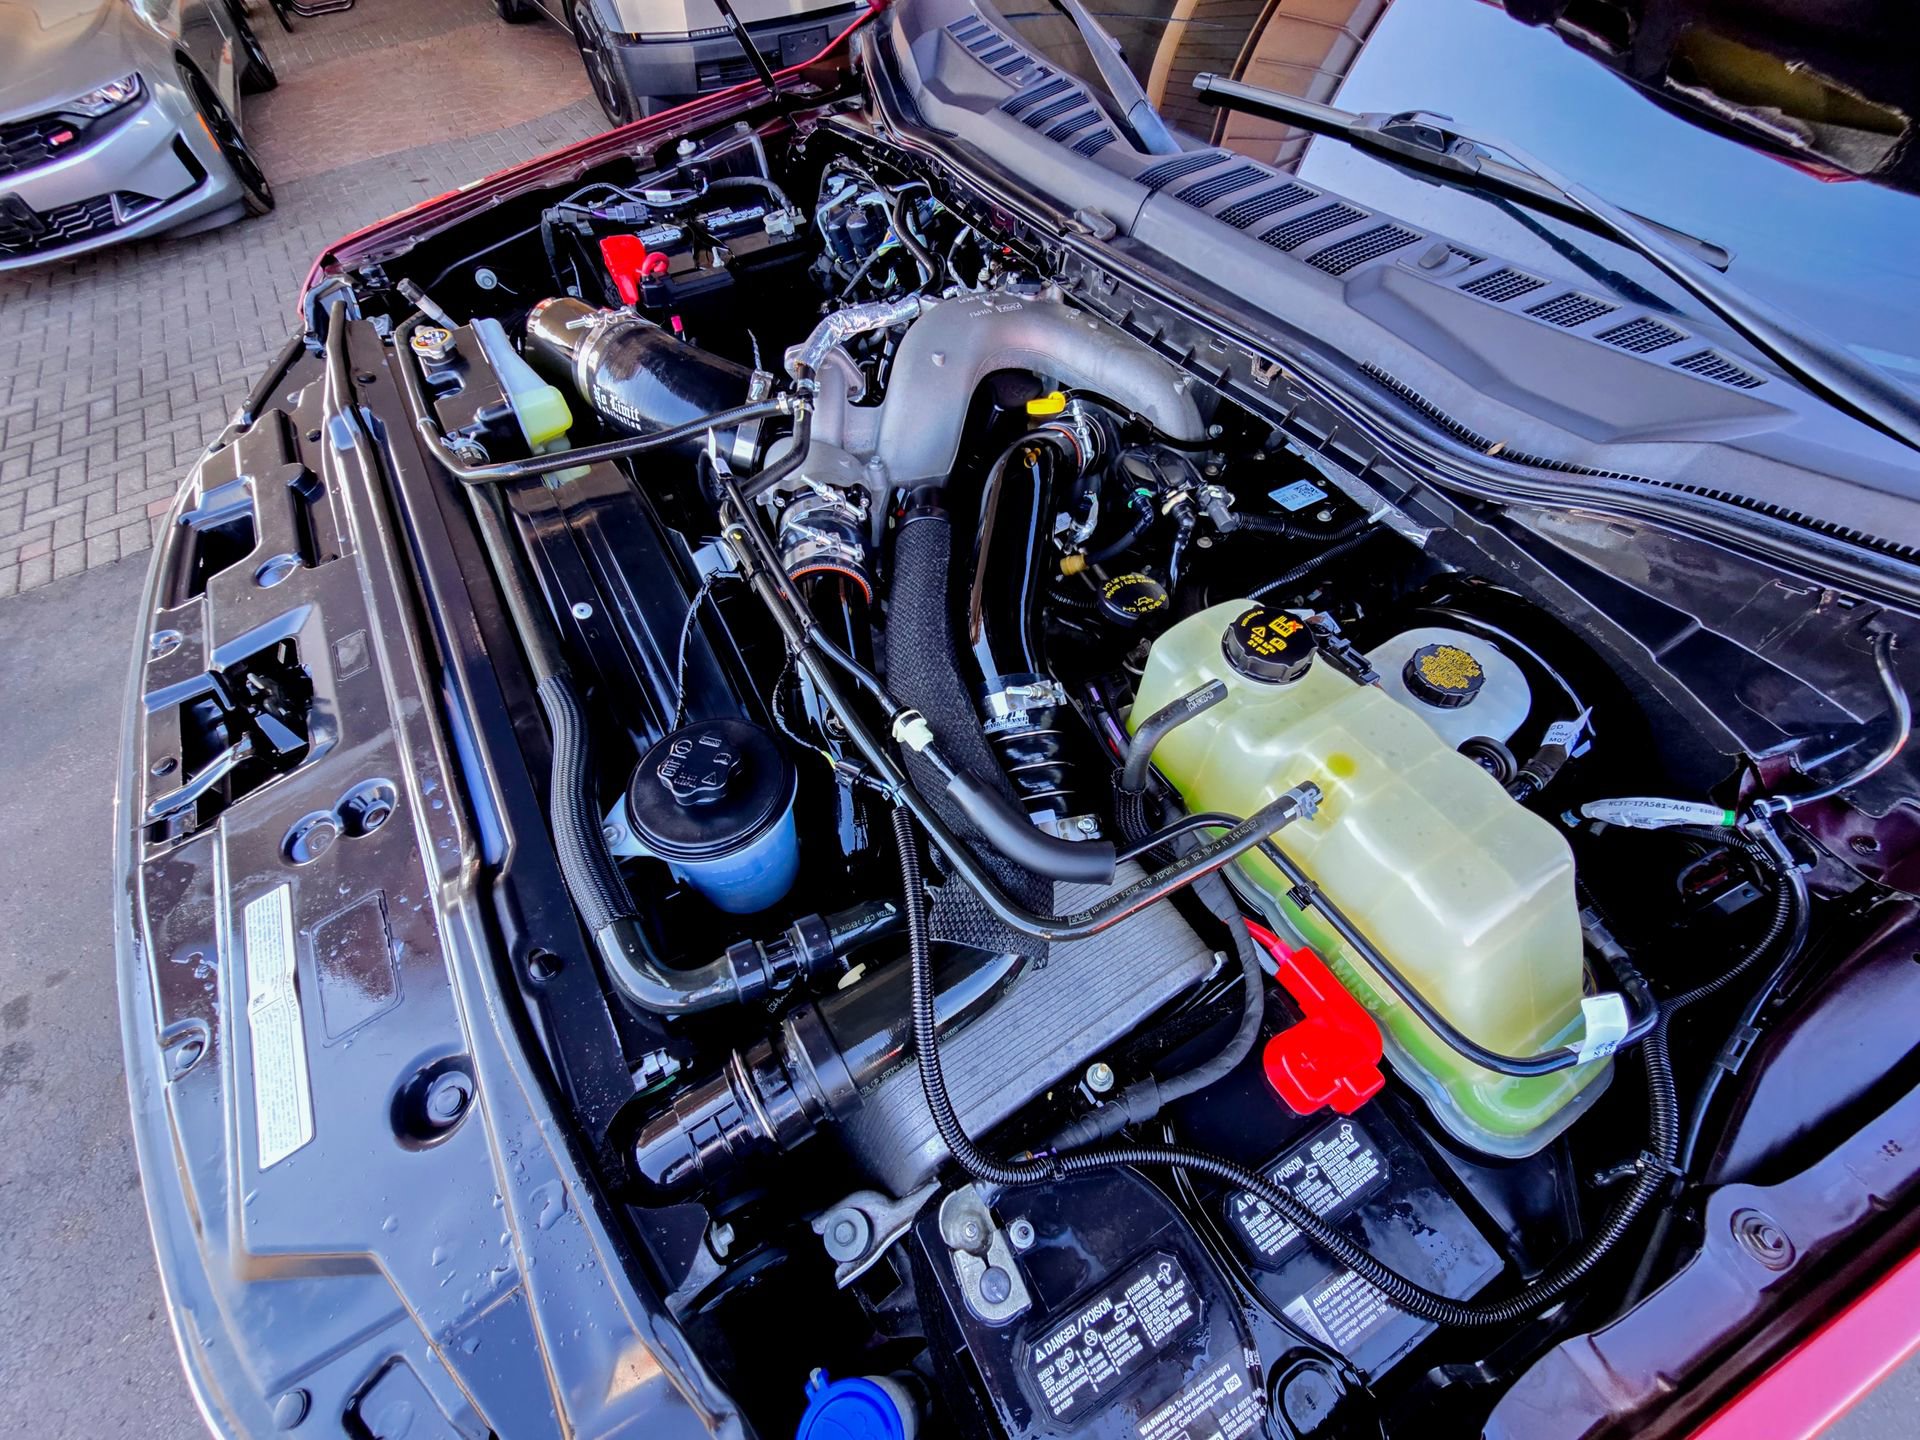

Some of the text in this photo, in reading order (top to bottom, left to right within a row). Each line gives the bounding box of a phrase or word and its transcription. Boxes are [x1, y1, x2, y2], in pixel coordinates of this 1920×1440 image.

[1311, 1269, 1359, 1307] AVERTISSEME
[1037, 1364, 1055, 1382] SHIELD
[1138, 1404, 1178, 1436] WARNING:
